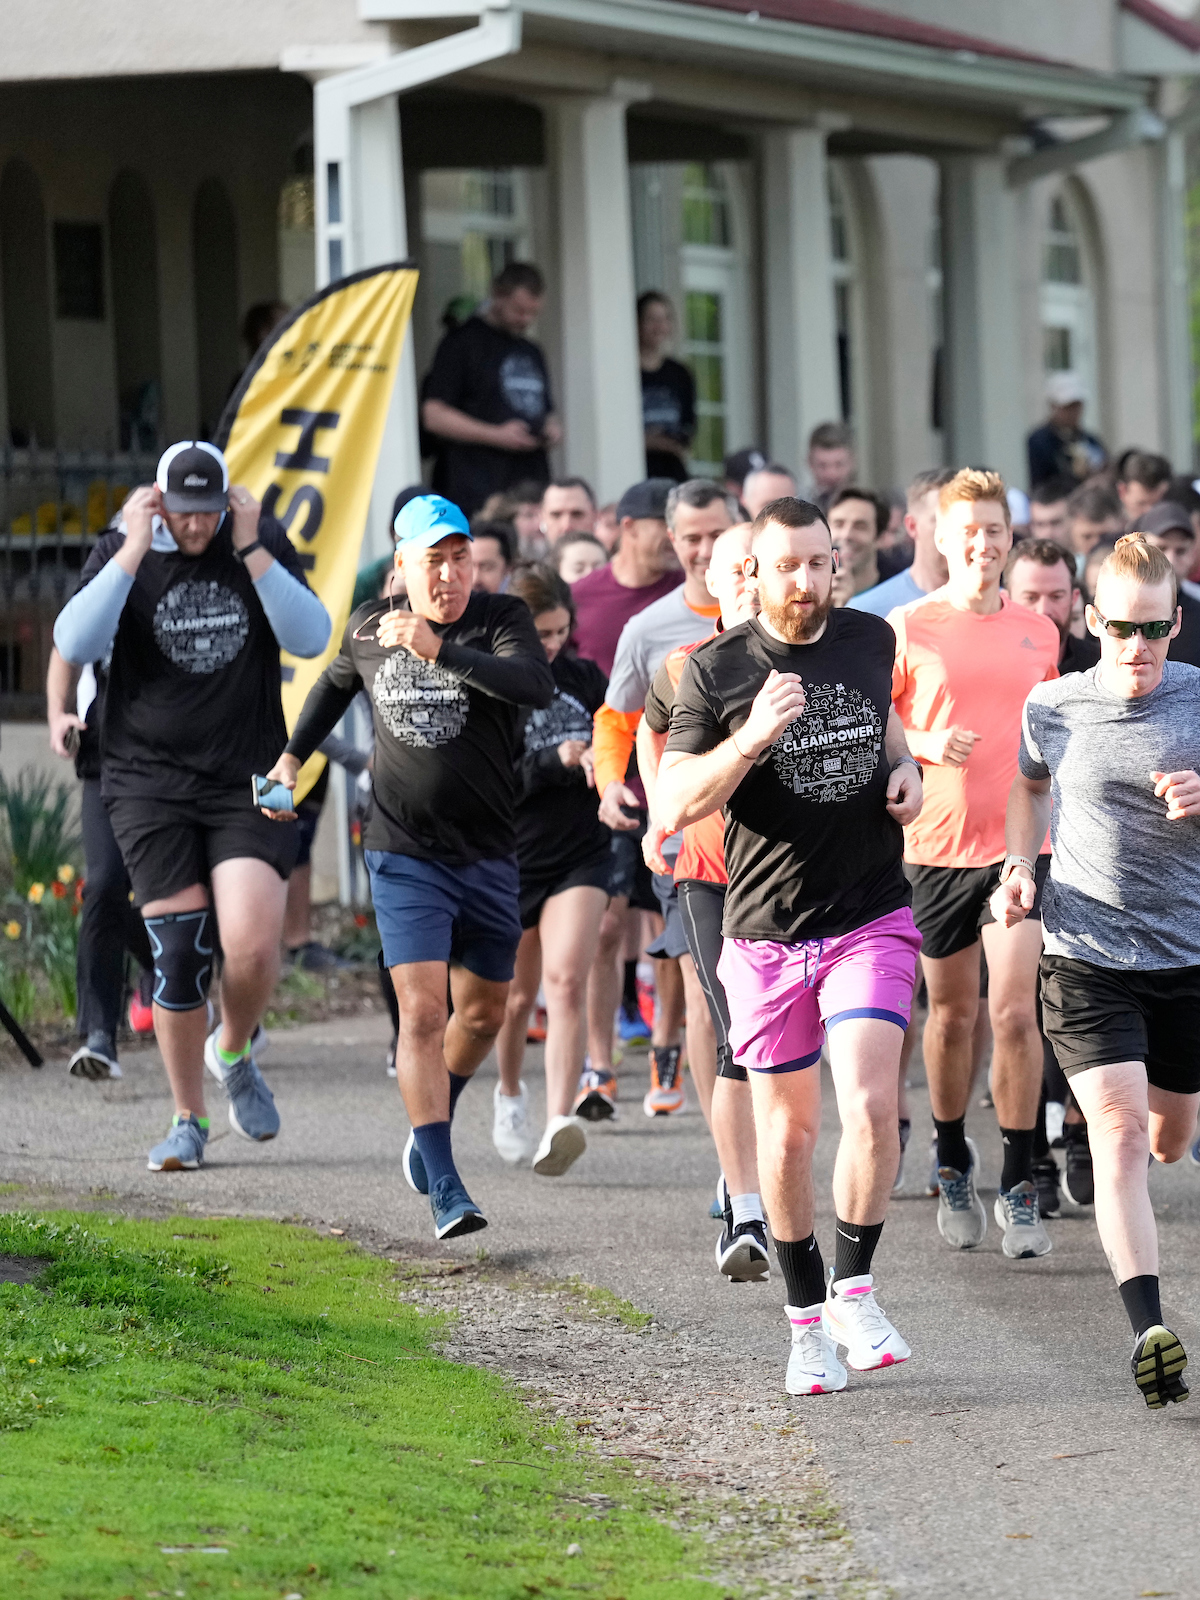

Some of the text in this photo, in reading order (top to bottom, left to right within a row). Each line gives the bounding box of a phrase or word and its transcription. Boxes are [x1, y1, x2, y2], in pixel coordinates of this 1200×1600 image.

[162, 614, 240, 631] CLEANPOWER
[378, 690, 459, 701] CLEANPOWER
[783, 725, 874, 753] CLEANPOWER
